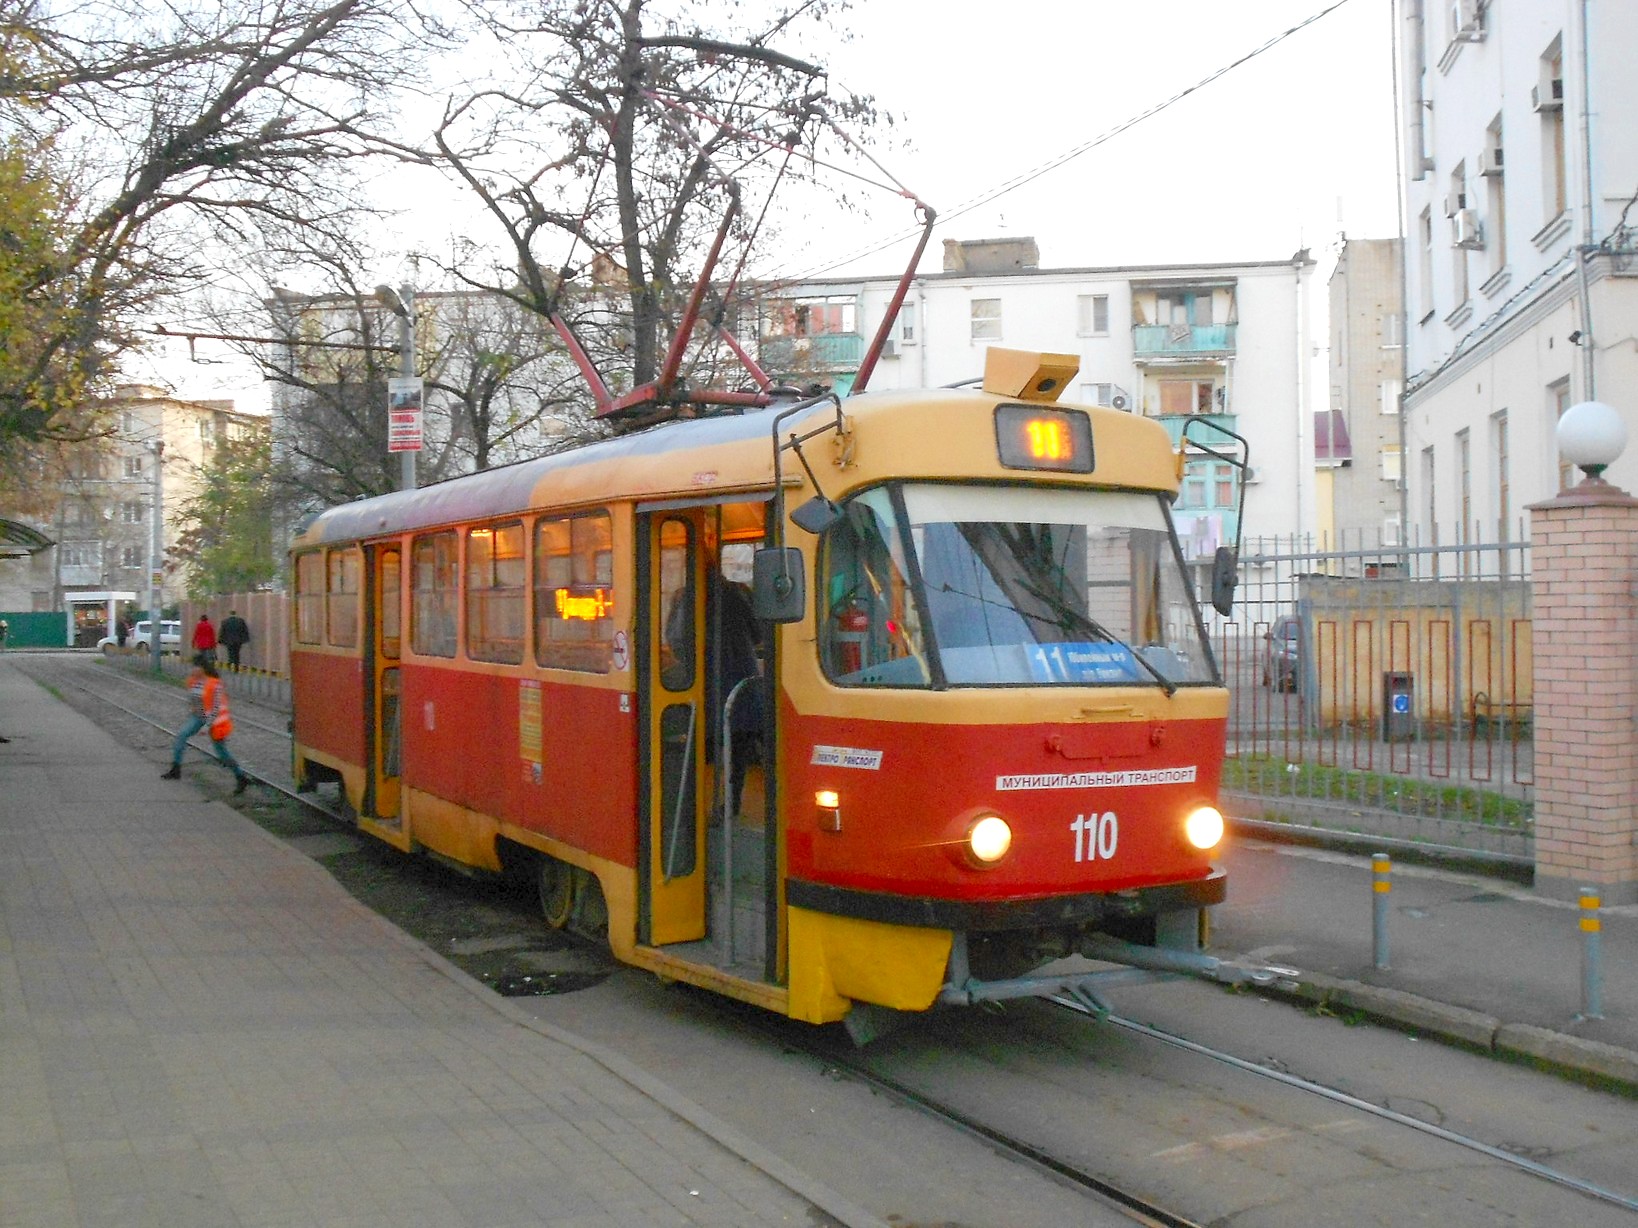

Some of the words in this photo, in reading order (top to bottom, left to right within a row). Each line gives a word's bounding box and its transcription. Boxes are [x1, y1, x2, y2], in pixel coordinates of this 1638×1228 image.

[1027, 421, 1060, 458] 11
[1035, 646, 1071, 682] 11
[1002, 773, 1124, 788] МУНИЦИПАЛЬНЫЙ
[1128, 769, 1194, 784] ТРАНСПОРТ
[1070, 811, 1119, 862] 110
